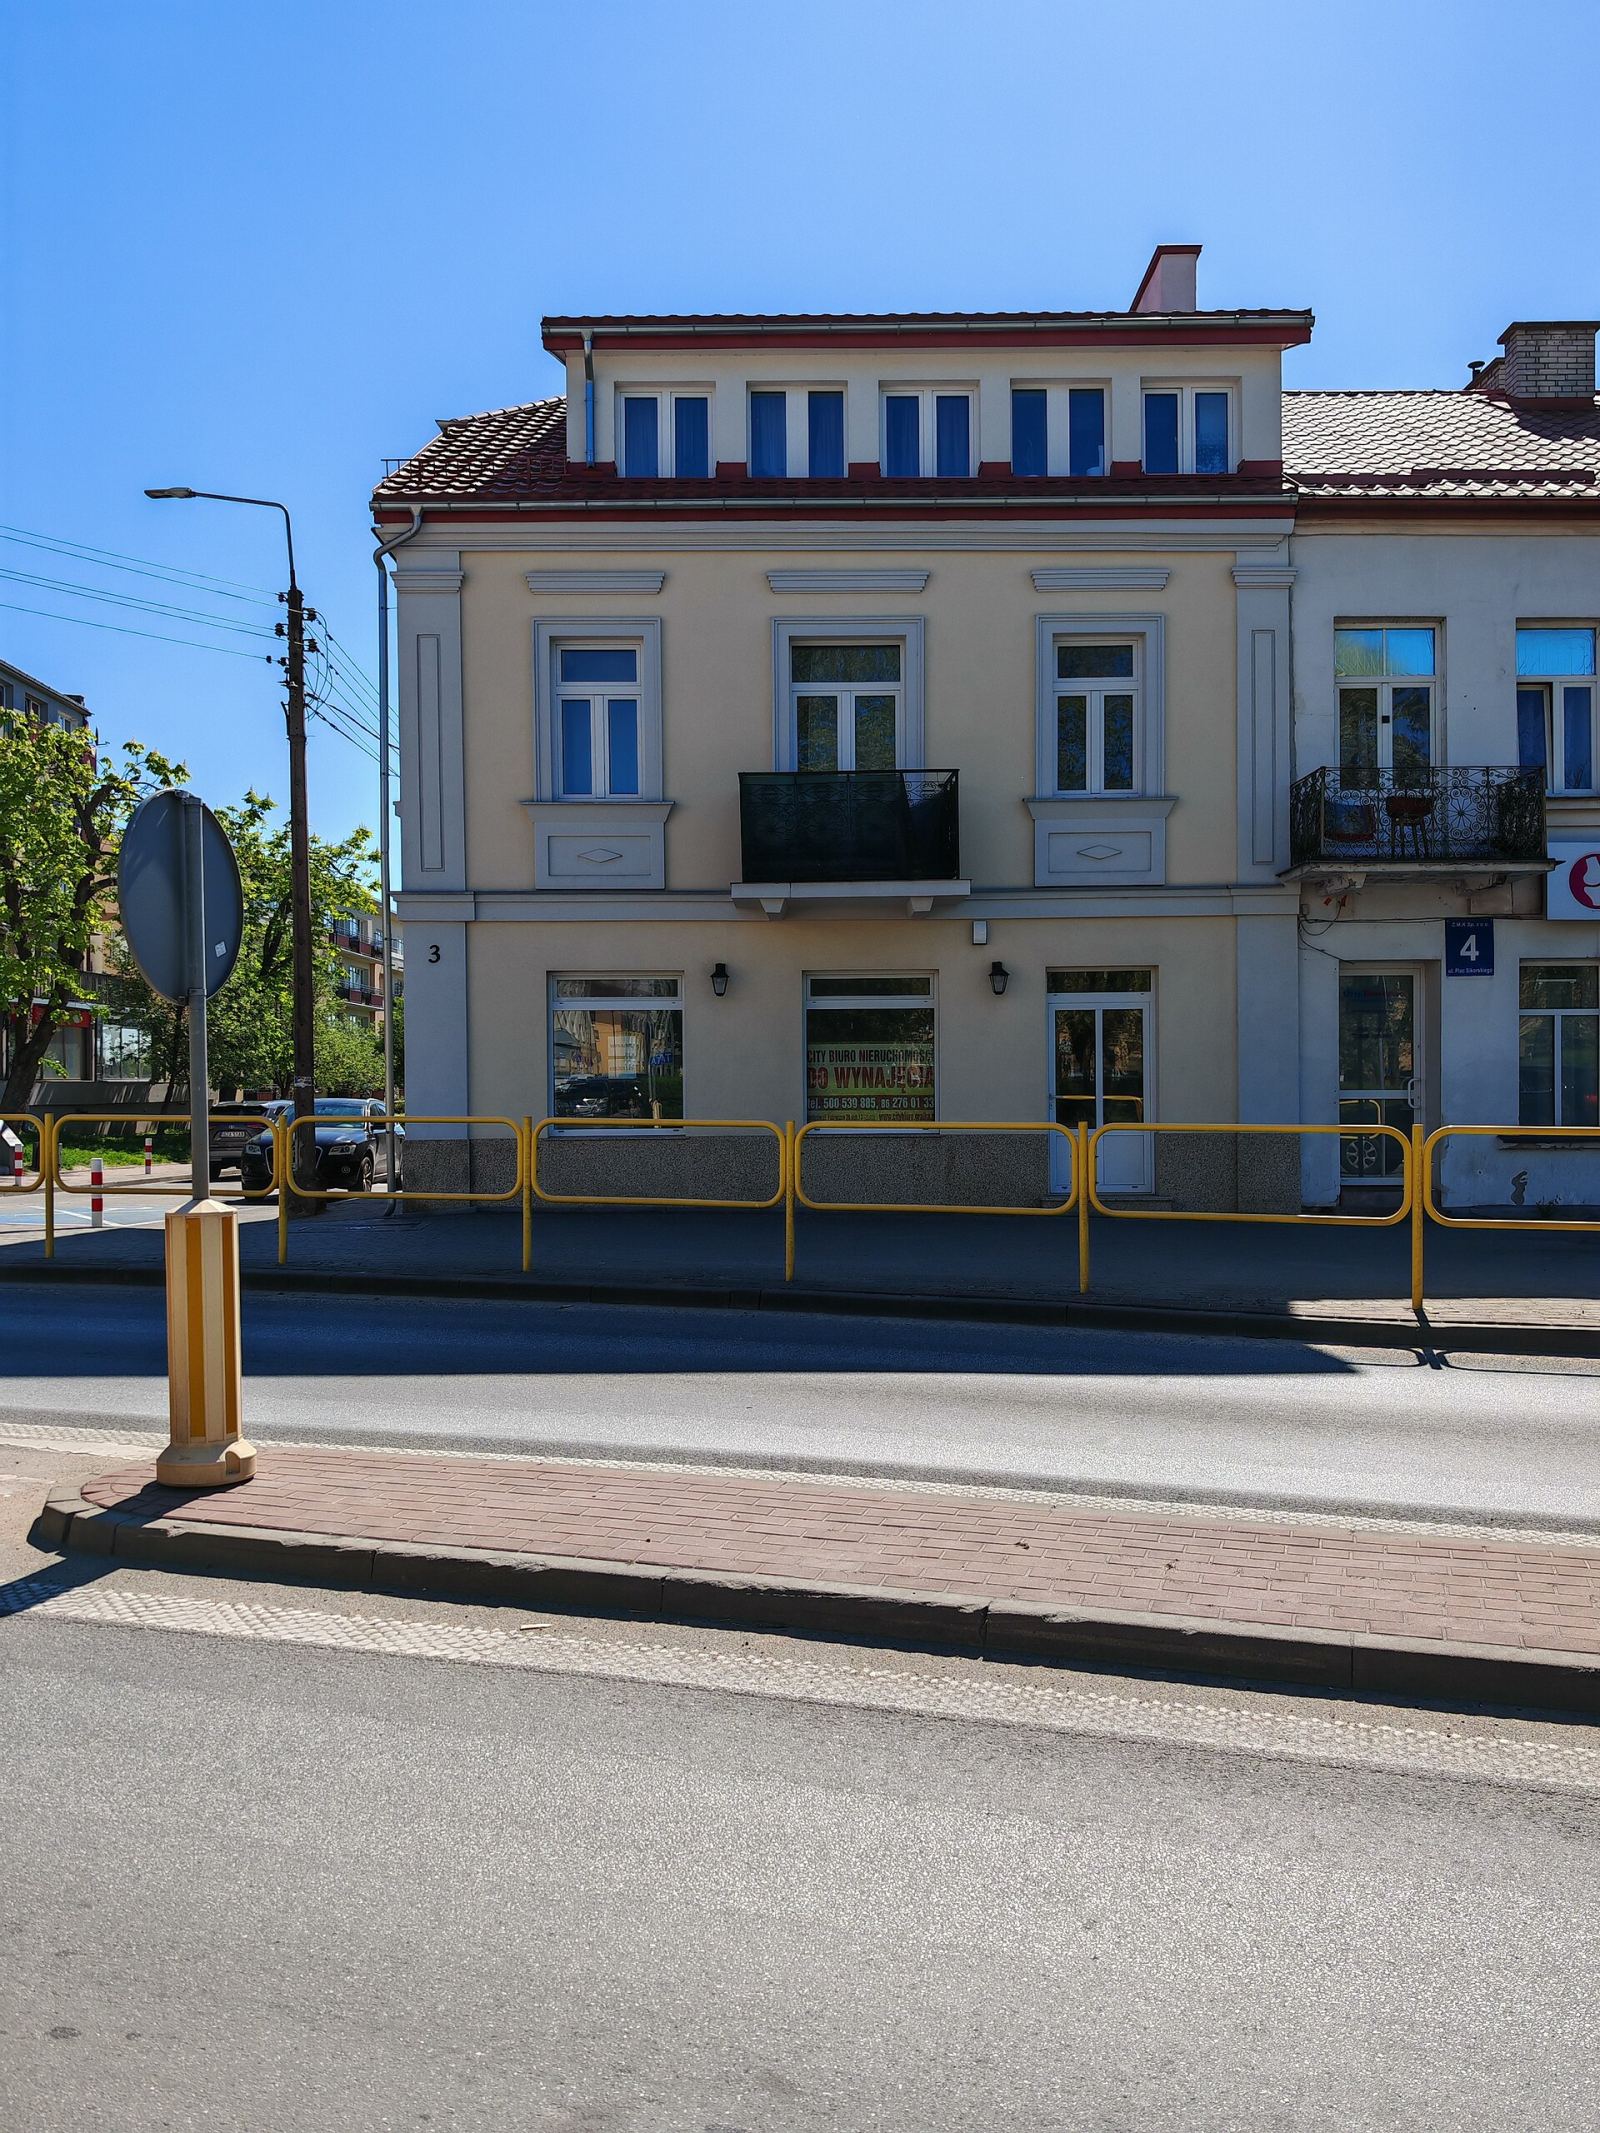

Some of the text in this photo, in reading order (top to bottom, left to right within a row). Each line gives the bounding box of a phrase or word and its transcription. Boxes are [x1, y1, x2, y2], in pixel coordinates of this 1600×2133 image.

[428, 944, 441, 964] 3
[1459, 934, 1480, 962] 4
[808, 1050, 826, 1063] CITY
[829, 1050, 856, 1063] BIURO
[808, 1066, 829, 1089] DO
[823, 1097, 840, 1109] 500
[841, 1097, 858, 1109] 539
